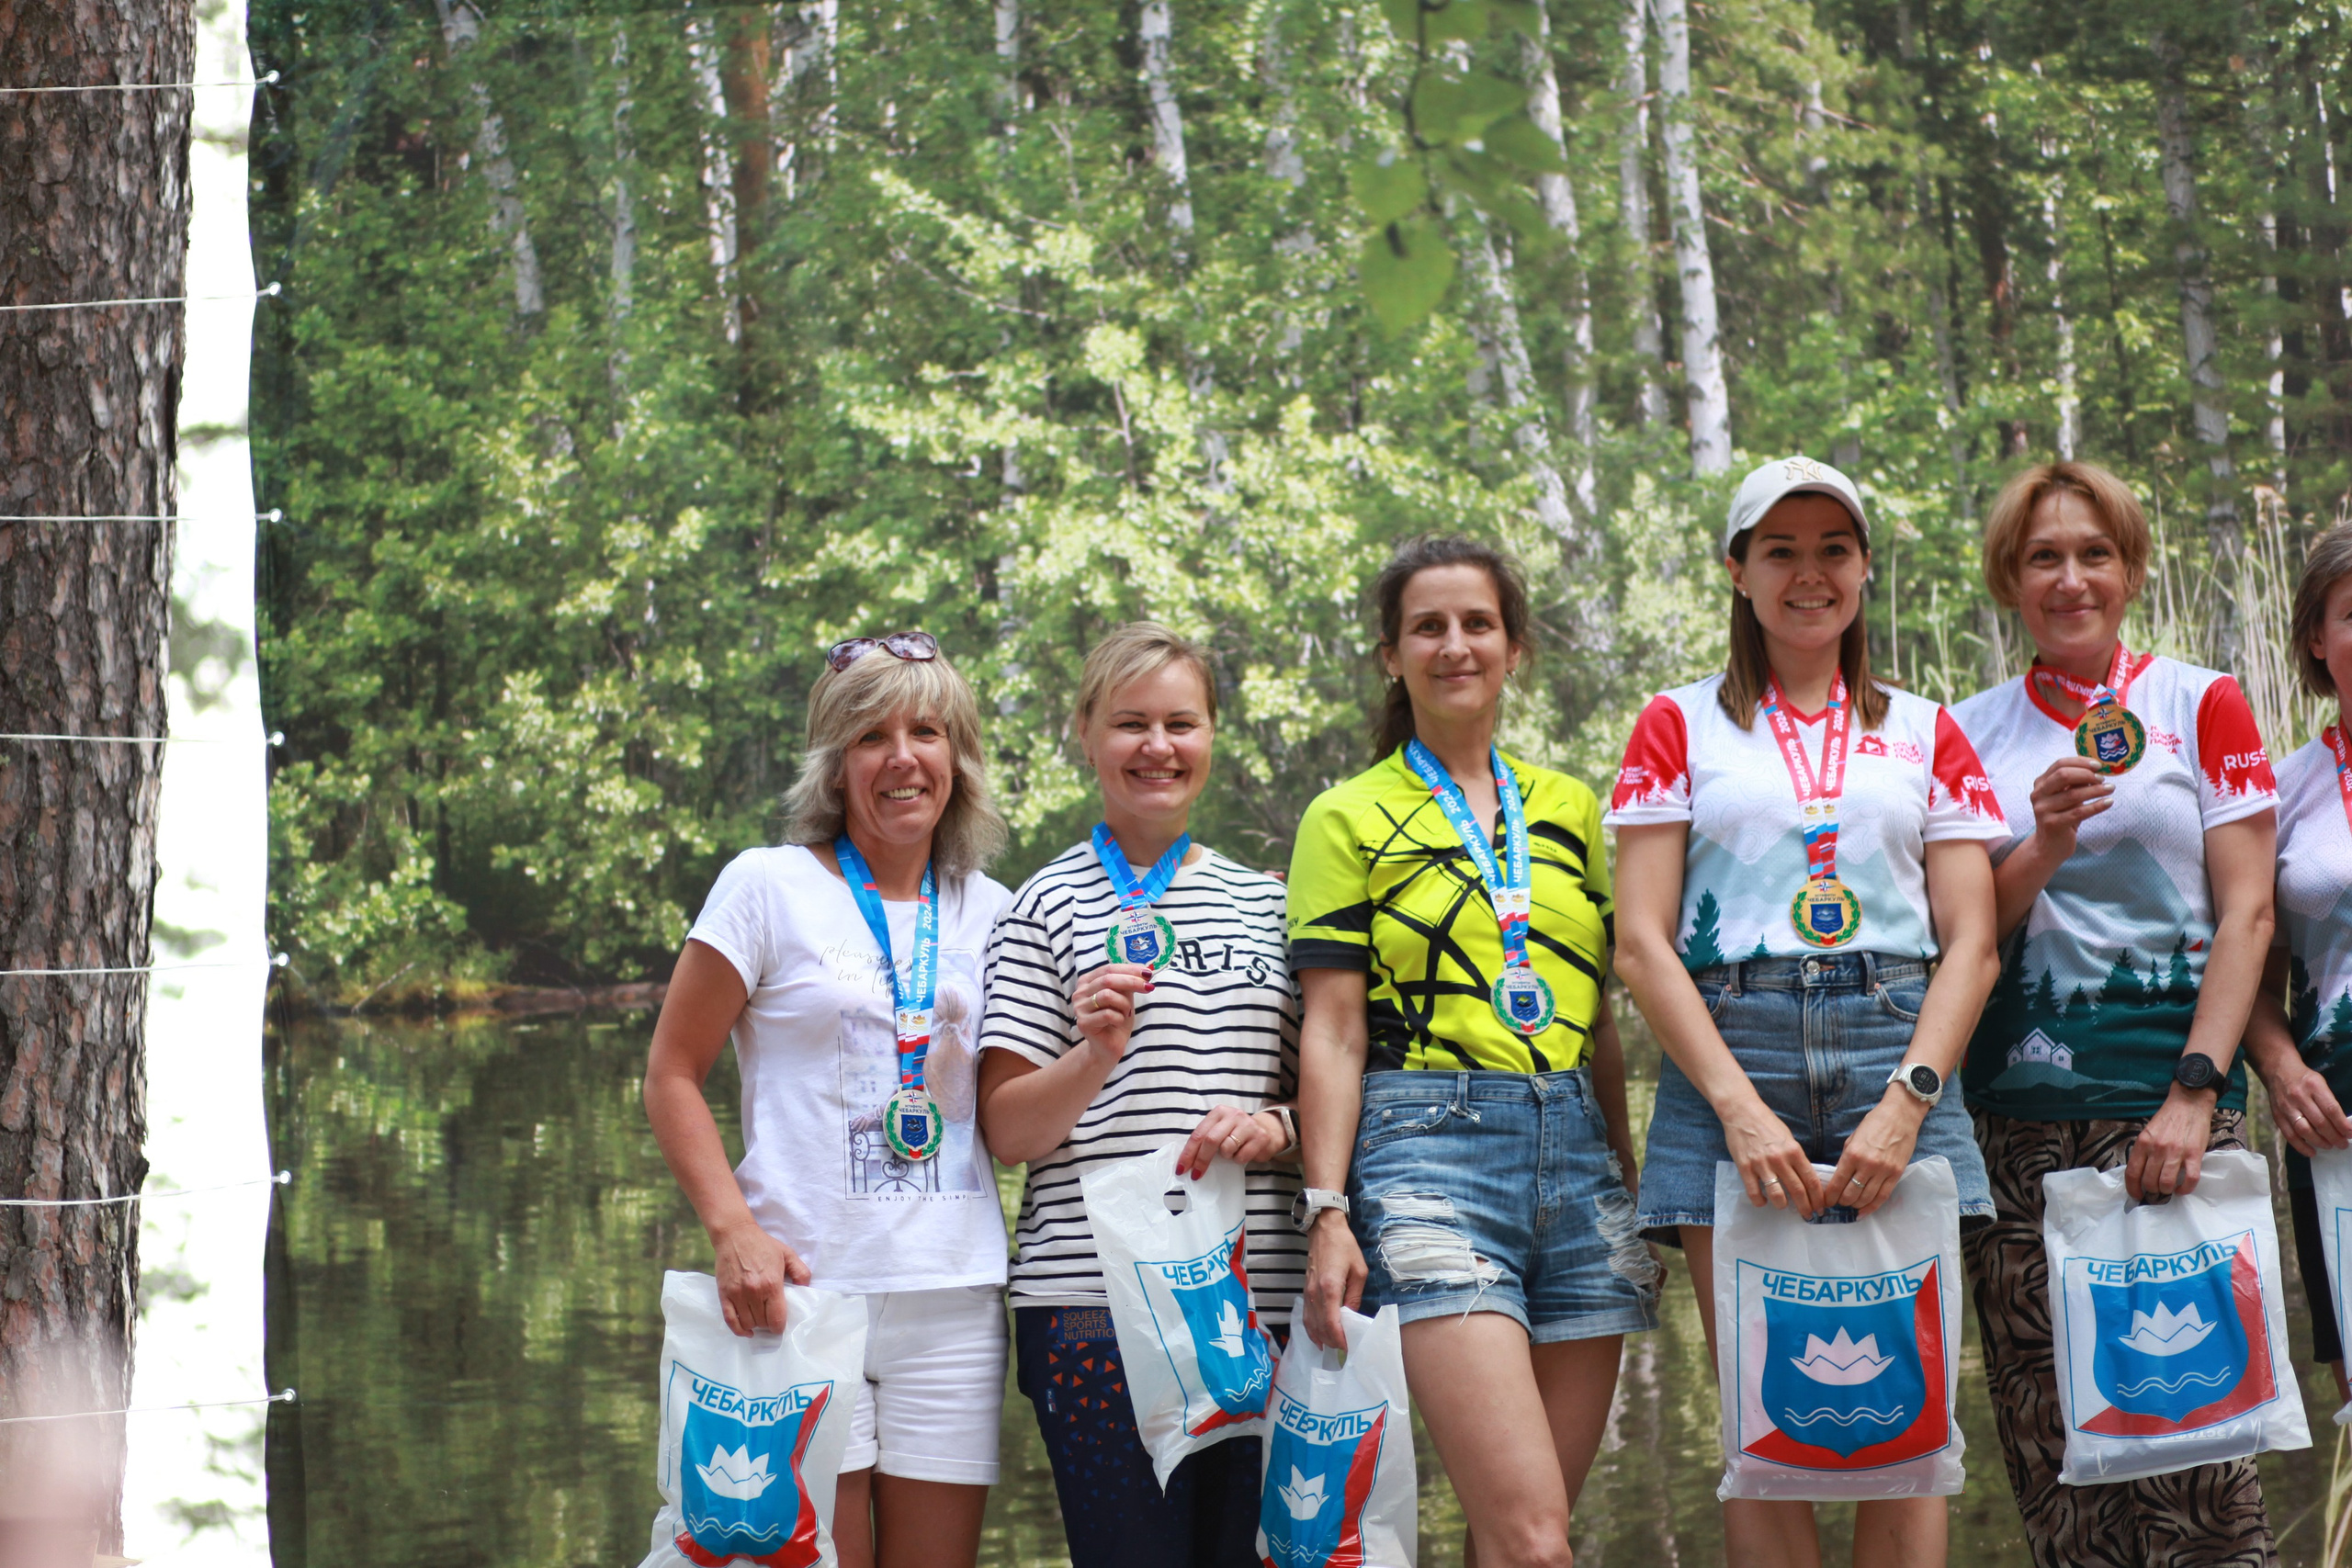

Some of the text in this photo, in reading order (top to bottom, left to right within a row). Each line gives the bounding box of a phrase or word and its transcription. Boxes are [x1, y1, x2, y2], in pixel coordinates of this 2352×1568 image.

[1774, 710, 1792, 733] 2024
[1832, 709, 1845, 732] 2024
[2088, 720, 2126, 733] ЧЕБАРКУЛЬ
[1441, 790, 1462, 814] 2024
[1505, 788, 1517, 813] 2024
[1460, 819, 1496, 882] ЧЕБАРКУЛЬ
[1511, 819, 1523, 883] ЧЕБАРКУЛЬ
[922, 904, 933, 931] 2024
[1120, 923, 1158, 935] ЧЕБАРКУЛЬ
[916, 937, 931, 1003] ЧЕБАРКУЛЬ
[1170, 940, 1272, 986] RIS
[899, 1107, 930, 1115] ЧЕБАРКУЛЬ
[2087, 1242, 2239, 1284] ЧЕБАРКУЛЬ
[1762, 1272, 1924, 1303] ЧЕБАРКУЛЬ
[1063, 1319, 1108, 1332] SPORTS
[1064, 1328, 1116, 1340] NUTRITIO
